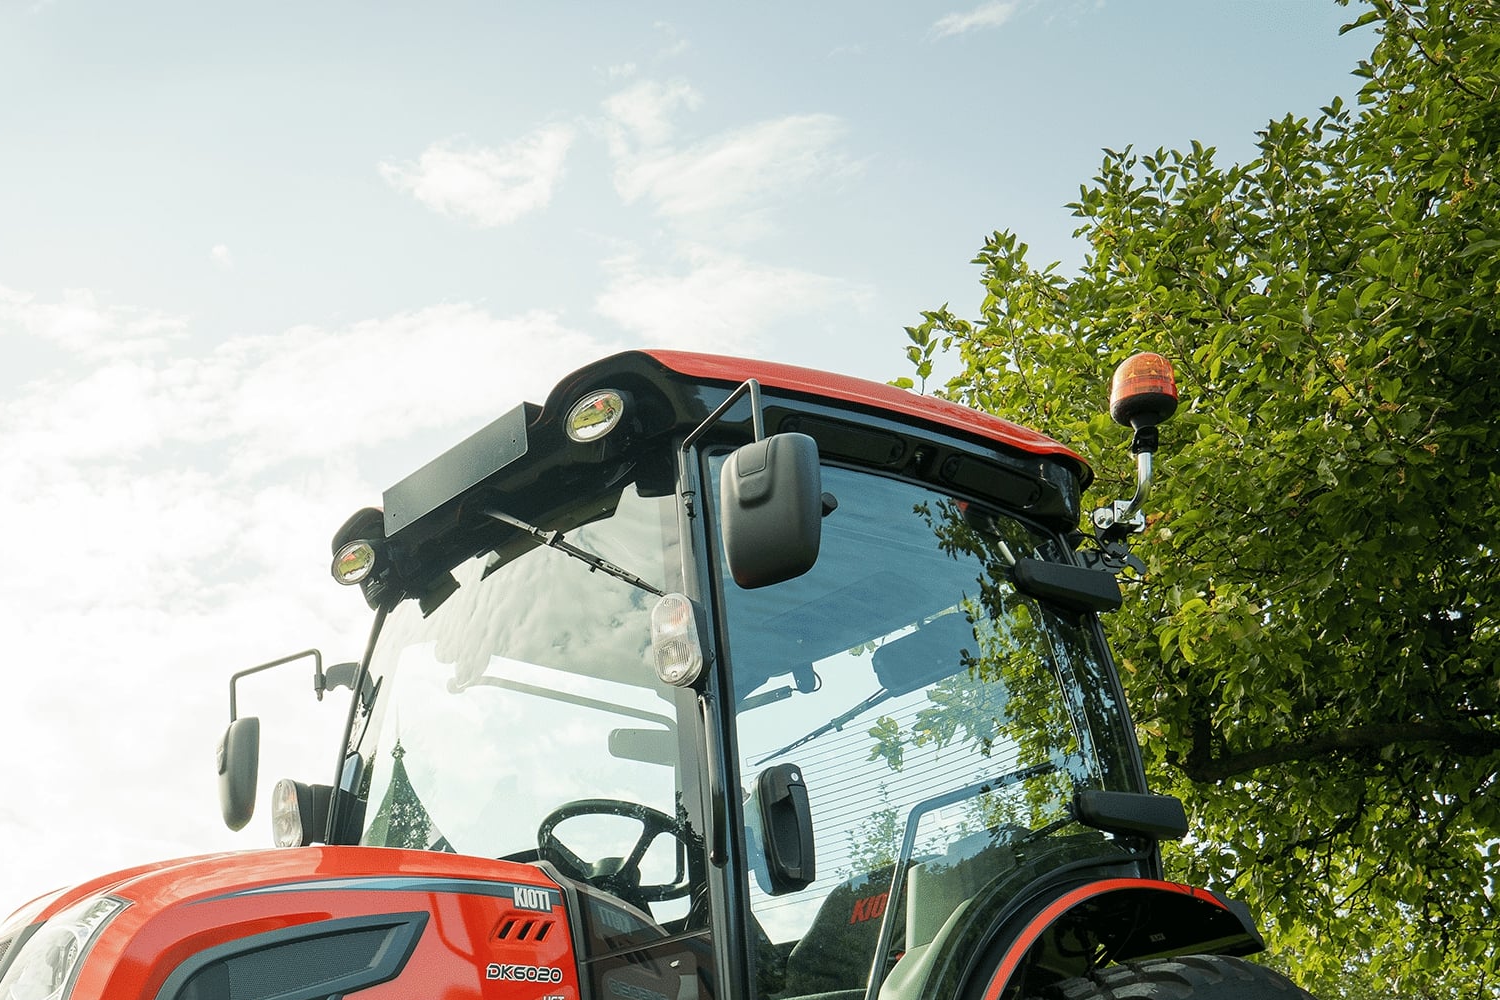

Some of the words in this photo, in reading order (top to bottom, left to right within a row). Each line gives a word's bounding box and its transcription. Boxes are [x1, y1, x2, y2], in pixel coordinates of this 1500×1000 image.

[513, 886, 550, 911] KIOTI
[850, 890, 890, 925] KIO
[486, 962, 563, 984] DK6020
